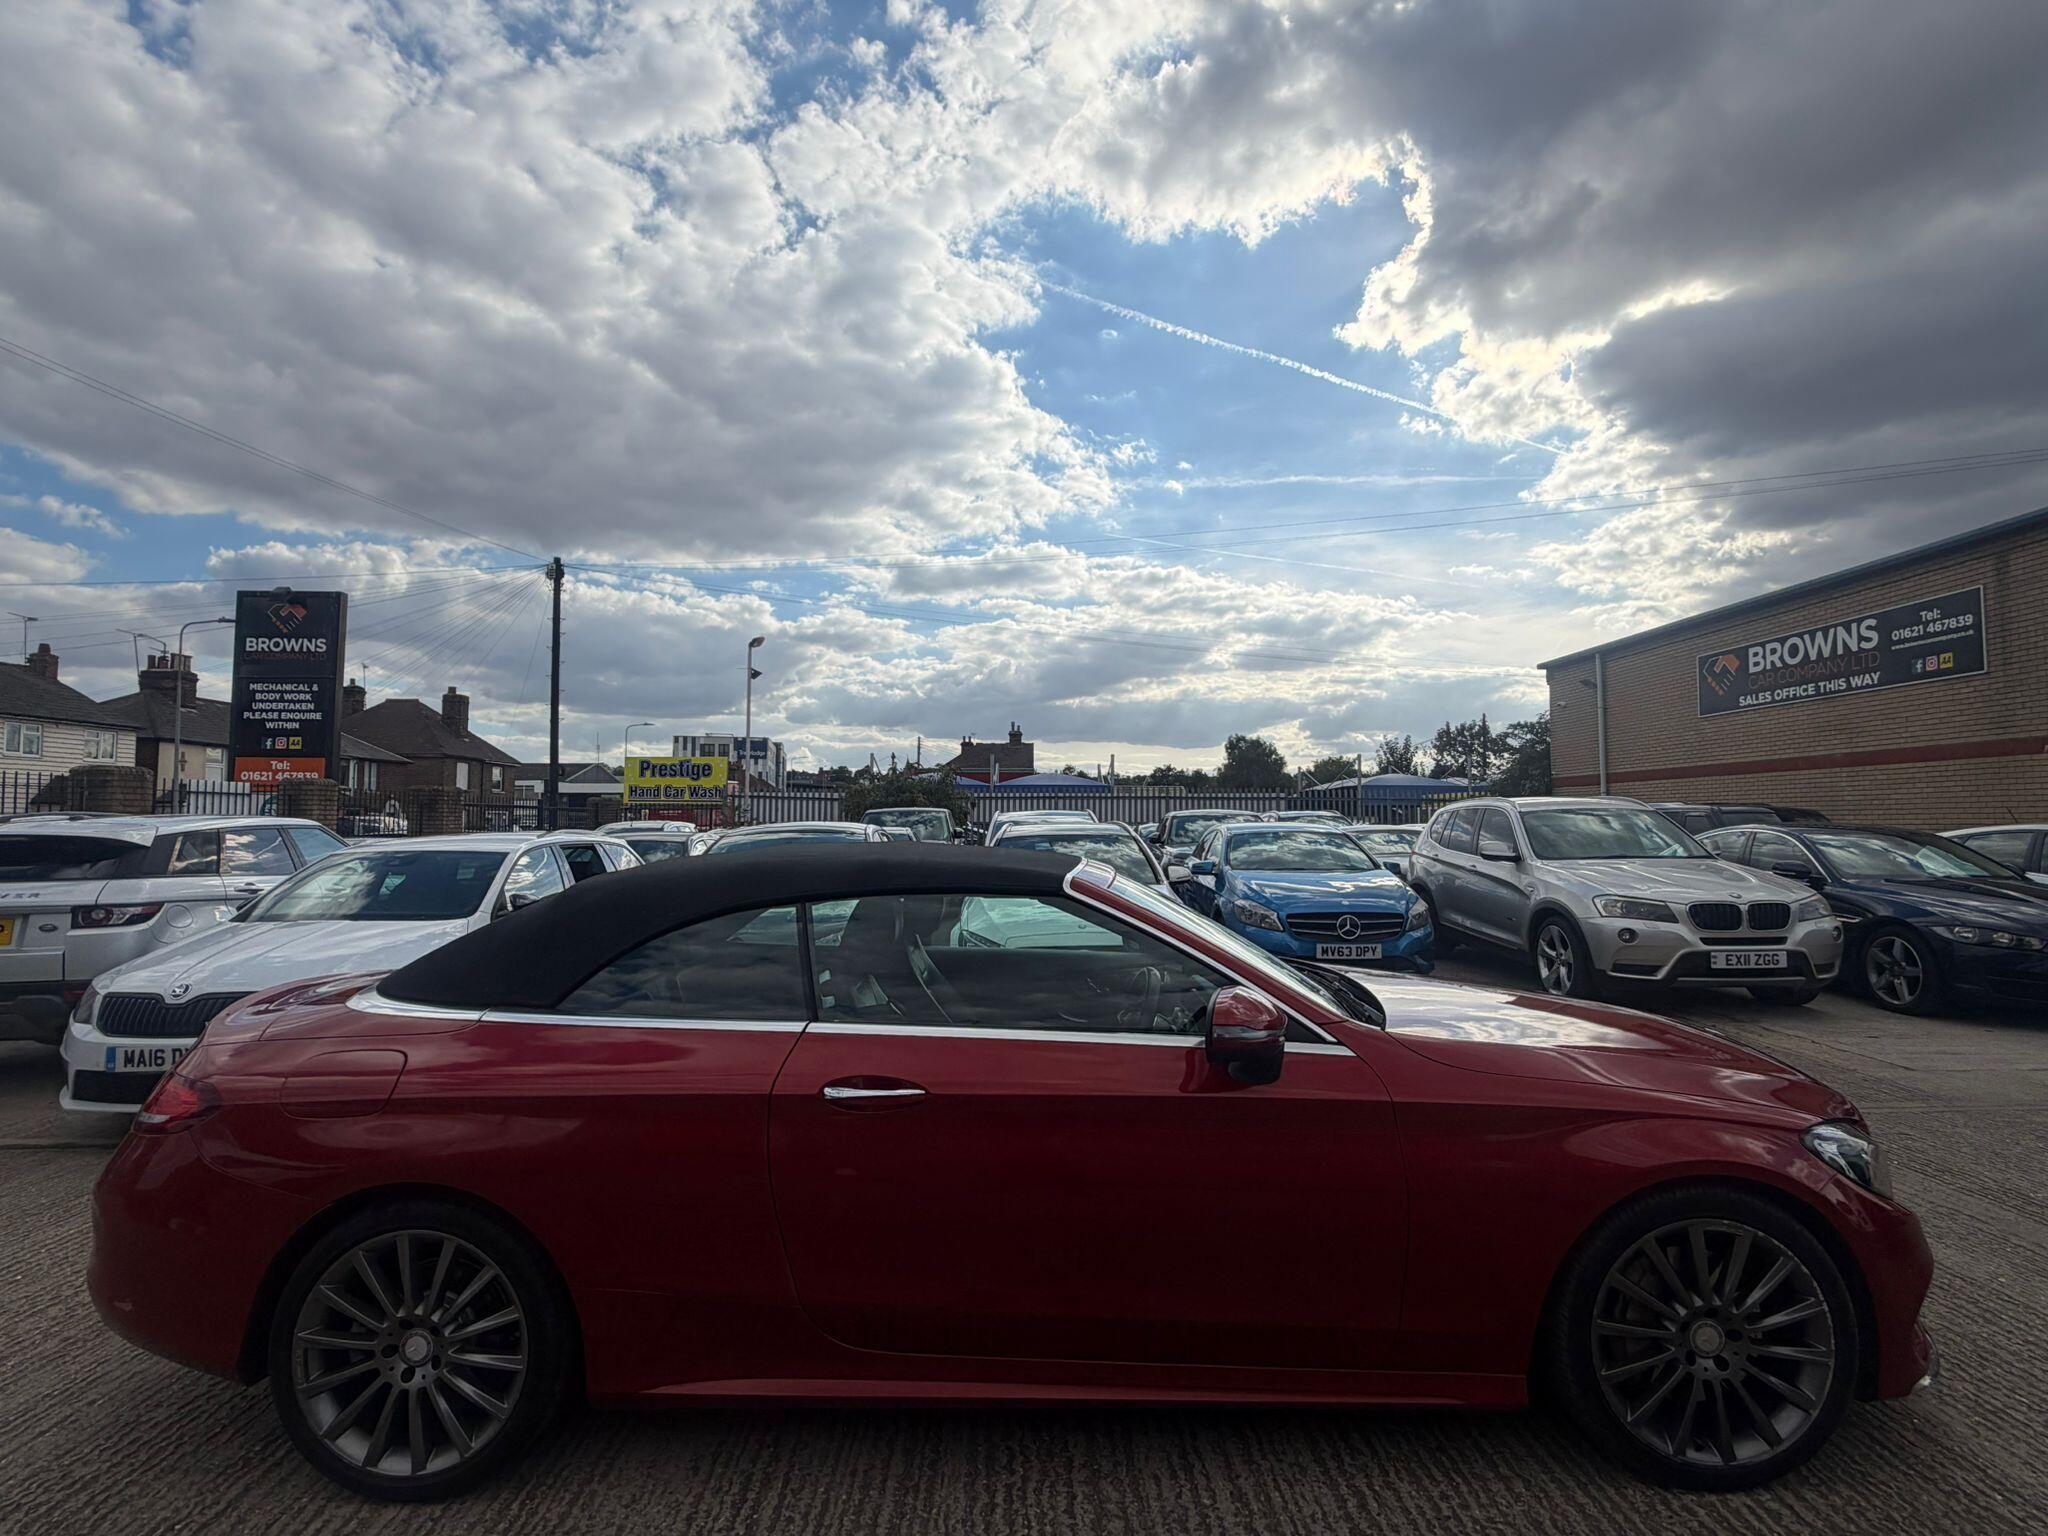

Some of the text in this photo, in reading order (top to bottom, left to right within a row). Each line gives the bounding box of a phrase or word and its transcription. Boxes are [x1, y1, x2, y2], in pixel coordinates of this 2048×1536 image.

[1919, 608, 1941, 621] Tel:
[1891, 625, 1924, 641] 01621
[1926, 614, 1974, 633] 467839
[245, 637, 327, 652] BROWNS
[1748, 618, 1880, 674] BROWNS
[1748, 651, 1881, 689] CAR COMPANY LTD
[249, 683, 319, 691] MECHANICAL &
[1738, 671, 1881, 707] SALES OFFICE THIS WAY
[255, 692, 313, 701] BODY WORK
[252, 702, 315, 710] UNDERTAKEN
[243, 711, 322, 720] PLEASE ENQUIRE
[265, 721, 300, 729] WITHIN
[270, 760, 290, 770] Tel:
[638, 758, 714, 781] Prestige
[240, 771, 273, 781] 01621
[629, 784, 723, 799] Hand Car Wash
[1321, 945, 1377, 957] MV63 DPY
[1725, 953, 1780, 967] EX11 ZGG
[123, 1048, 166, 1068] MA16
